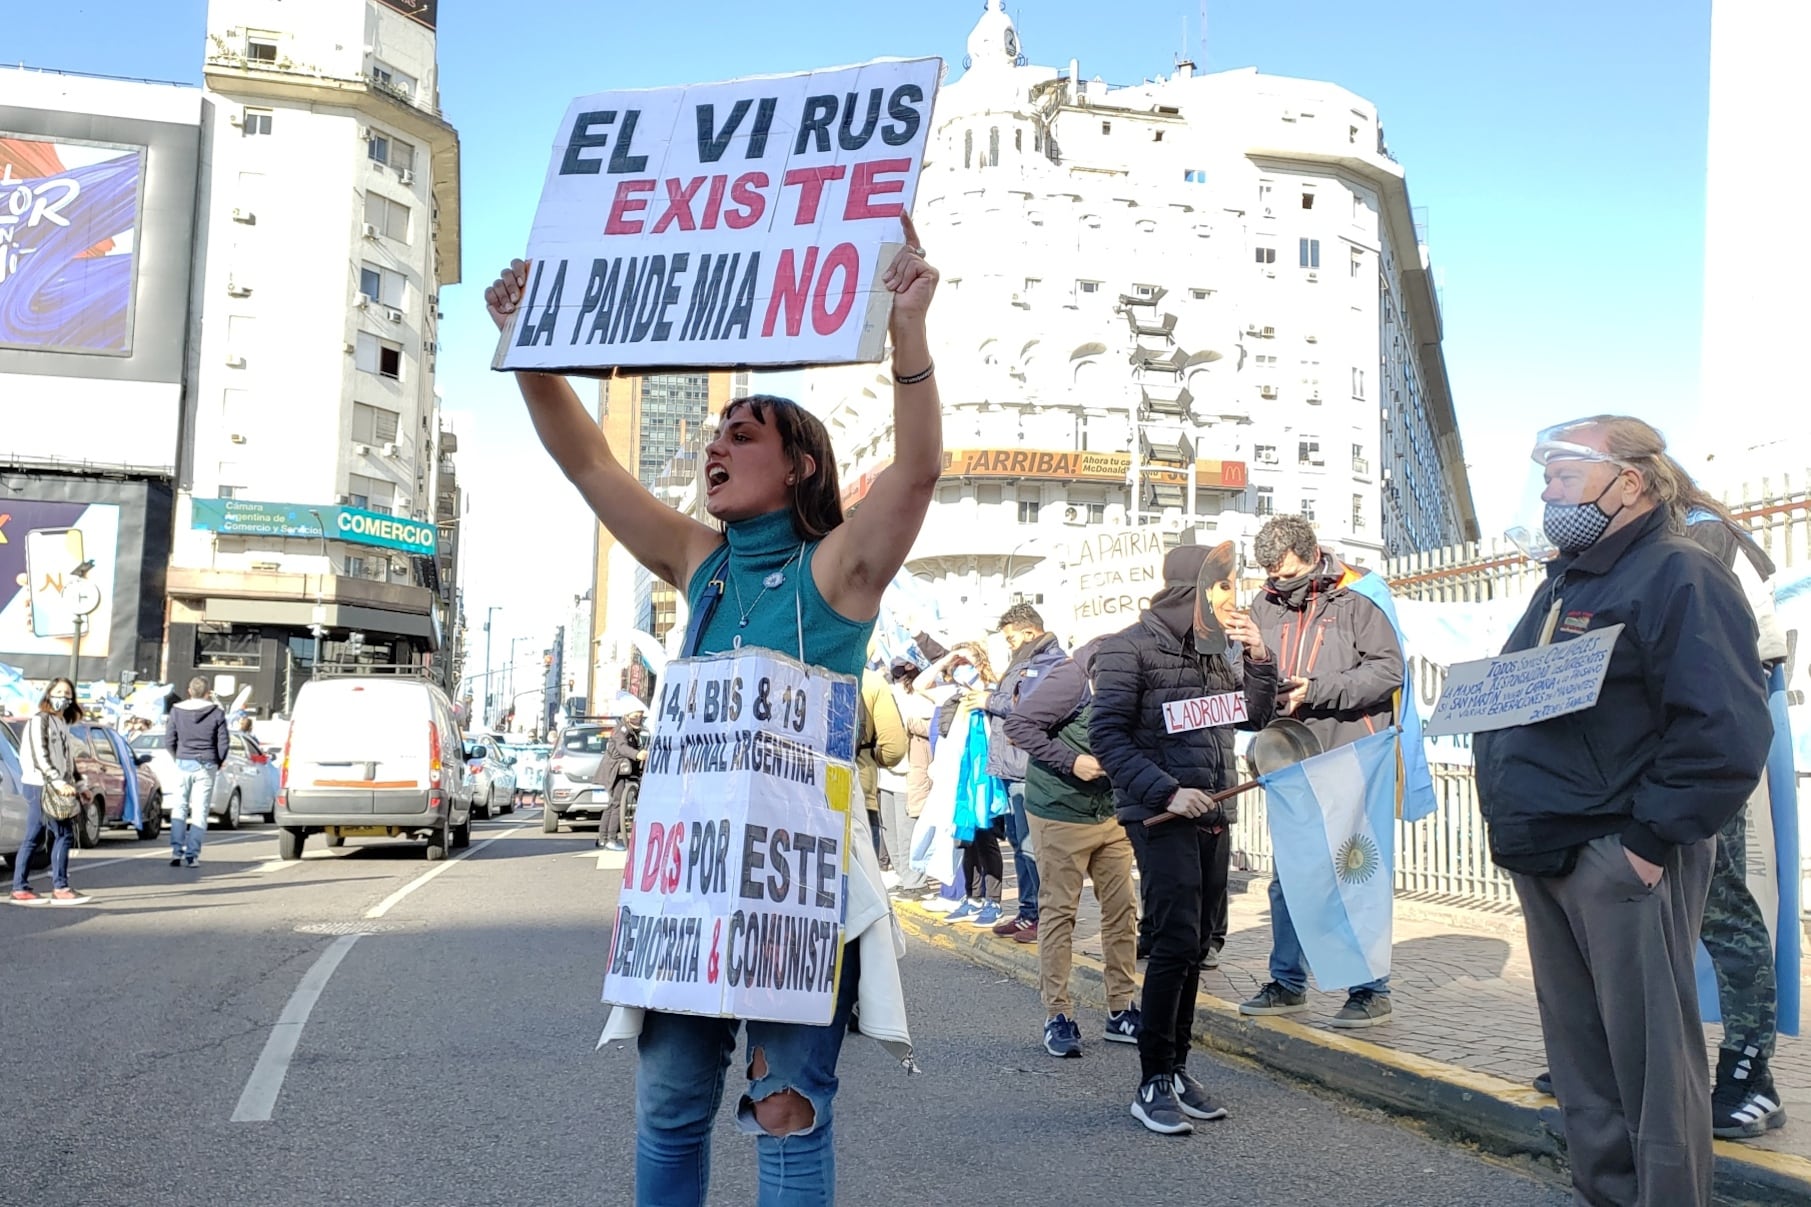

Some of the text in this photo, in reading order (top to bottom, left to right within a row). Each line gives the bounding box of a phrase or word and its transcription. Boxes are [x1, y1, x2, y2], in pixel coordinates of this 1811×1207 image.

[559, 110, 649, 175] EL
[516, 259, 568, 347] LA
[761, 242, 860, 338] NO
[965, 450, 1080, 475] ¡ARRIBA!
[1082, 456, 1109, 465] Ahora
[1110, 457, 1119, 466] tu
[224, 512, 286, 523] Argentina de
[225, 501, 263, 511] Cámara
[223, 521, 271, 532] Comercio
[272, 525, 280, 534] y
[337, 512, 434, 547] COMERCIO
[1080, 565, 1154, 590] ESTA EN
[704, 677, 743, 723] BIS
[753, 677, 772, 722] &
[782, 685, 806, 732] 19
[1166, 693, 1247, 730] LADRONA
[730, 729, 815, 785] ARGENTINA
[686, 818, 731, 895] POR
[740, 823, 838, 909] ESTE
[707, 918, 721, 984] &
[727, 909, 838, 993] COMUNISTA
